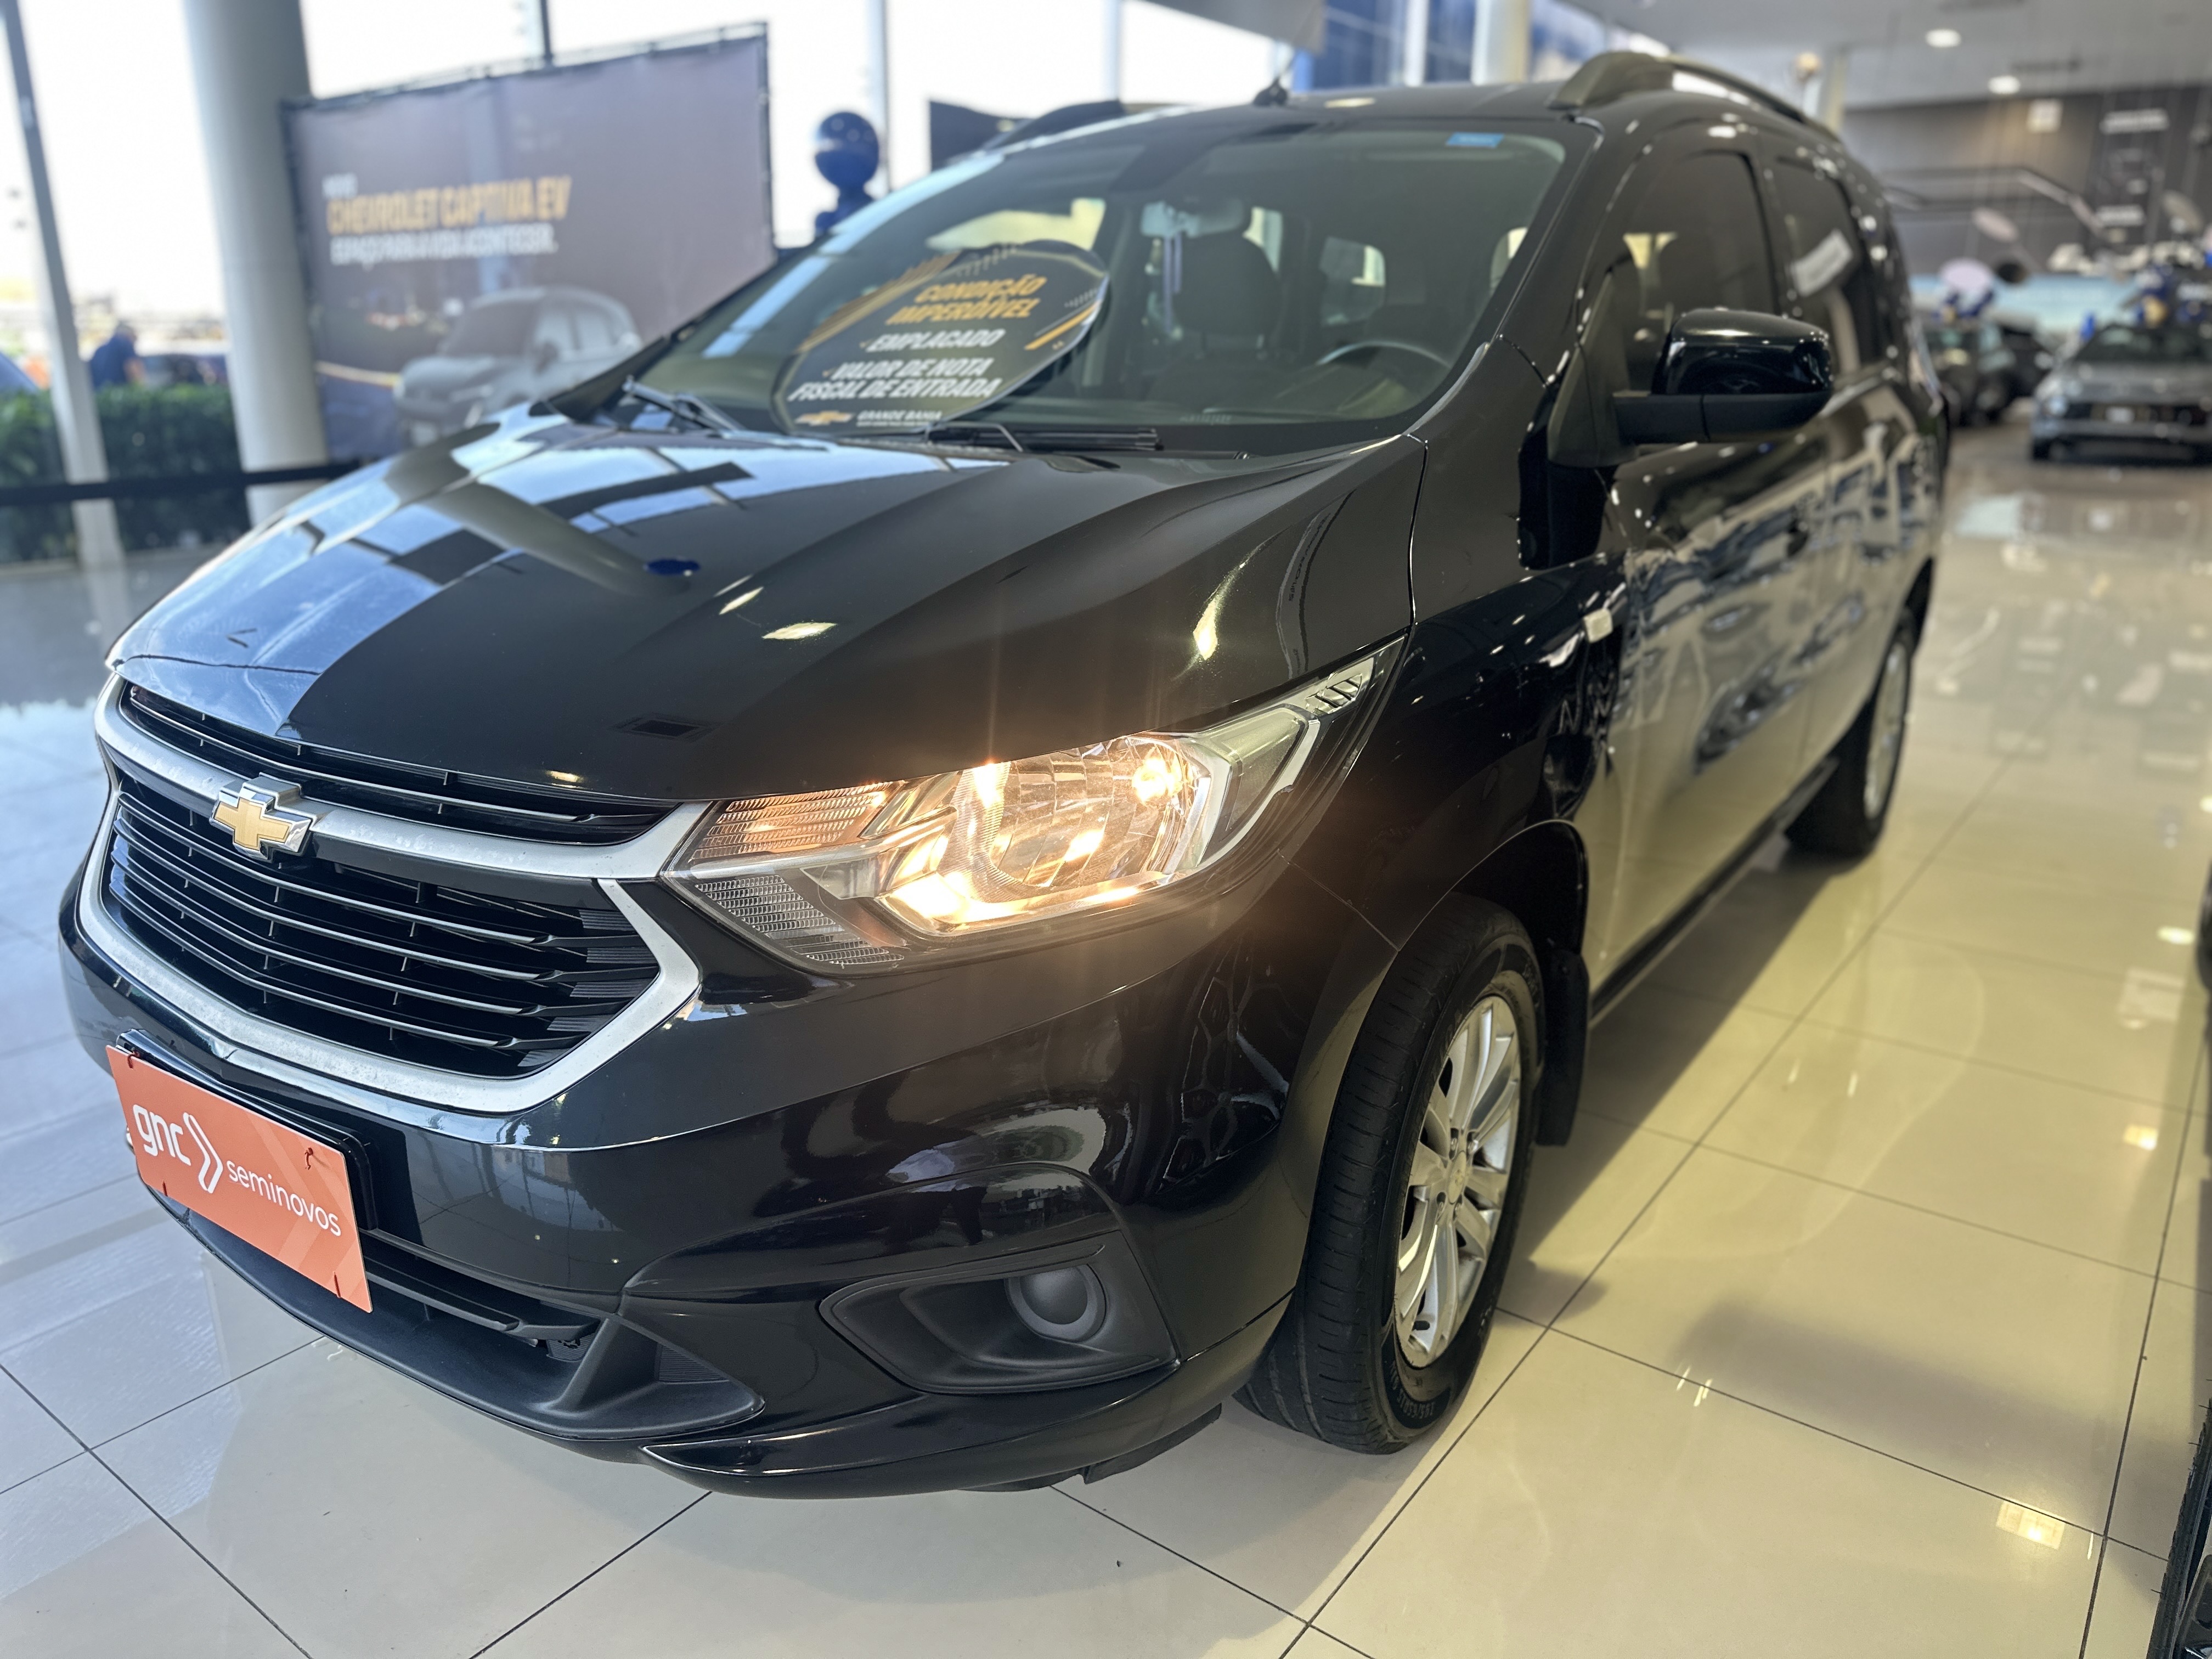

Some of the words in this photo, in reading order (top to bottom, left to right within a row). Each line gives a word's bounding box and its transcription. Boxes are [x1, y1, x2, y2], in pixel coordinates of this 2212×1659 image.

[328, 190, 438, 234] CHEVROLET
[441, 179, 535, 226] CAPTIVA
[537, 176, 572, 219] EV
[915, 275, 1047, 302] CONDIÇÃO
[886, 298, 1041, 325] IMPERDÍVEL
[865, 328, 1006, 353] EMPLACADO
[830, 359, 905, 381] VALOR
[894, 358, 936, 379] DE
[925, 357, 995, 378] NOTA
[787, 381, 861, 402] FISCAL
[858, 379, 900, 399] DE
[889, 377, 1003, 399] ENTRADA
[132, 1104, 191, 1166] gnc
[226, 1159, 342, 1237] seminovos
